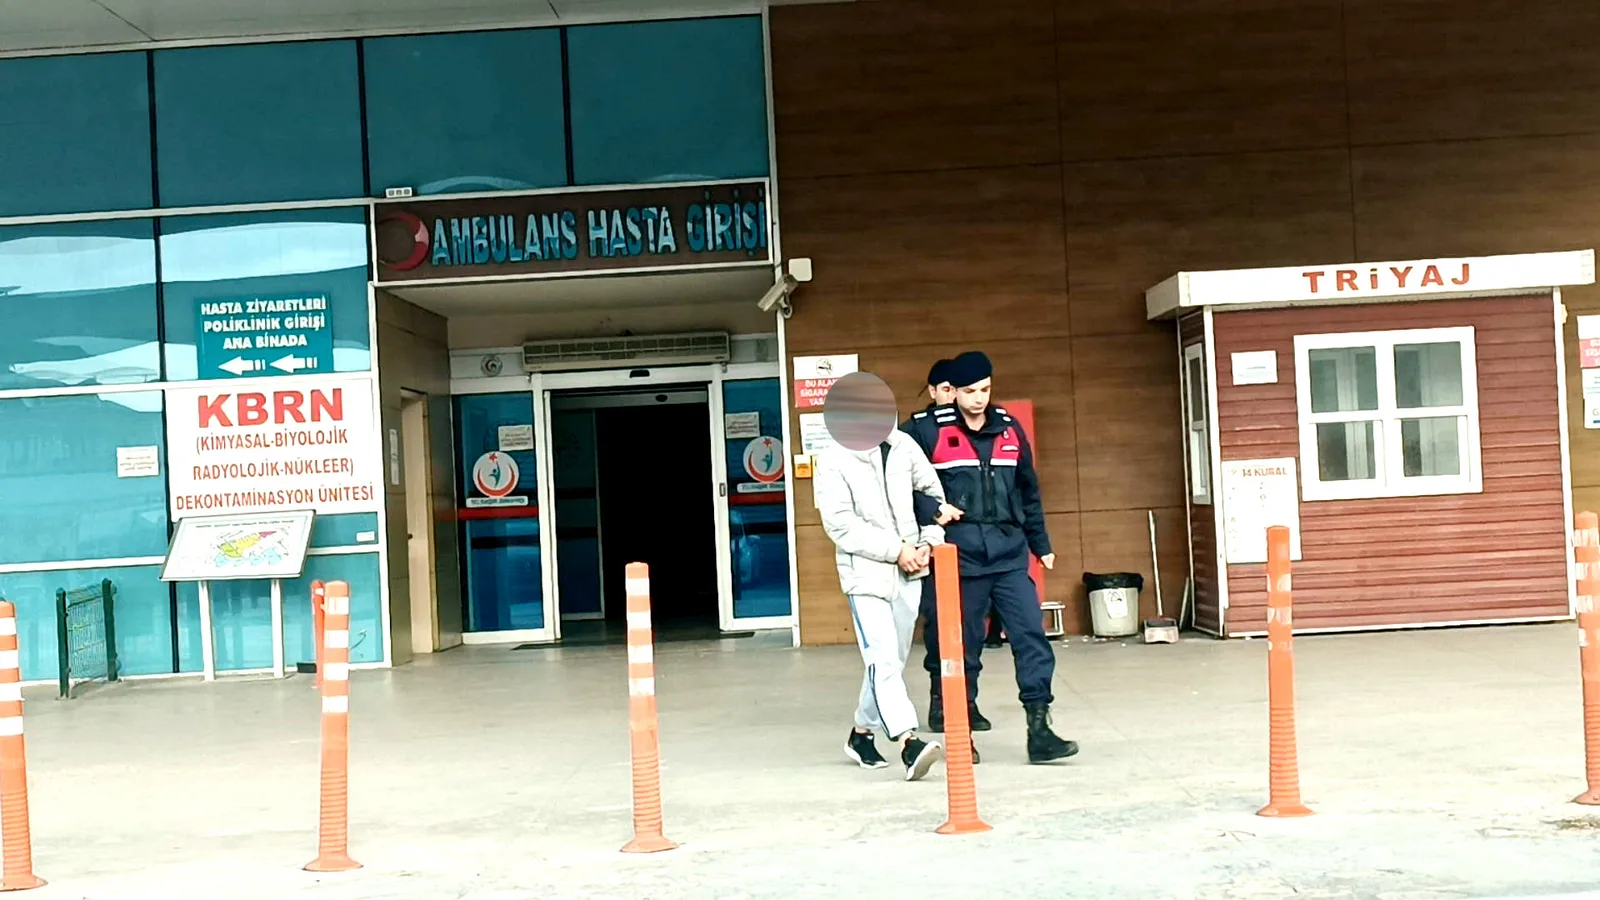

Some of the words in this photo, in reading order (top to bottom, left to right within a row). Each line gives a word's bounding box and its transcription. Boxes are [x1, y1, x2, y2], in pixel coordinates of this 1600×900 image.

[431, 210, 577, 266] AMBULANS
[587, 206, 676, 257] HASTA
[686, 188, 766, 256] GİRİŞİ
[201, 302, 242, 315] HASTA
[246, 295, 326, 313] ZİYARETLERİ
[204, 315, 281, 333] POLİKLİNİK
[284, 312, 325, 331] GİRİŞİ
[223, 336, 252, 350] ANA
[255, 332, 307, 348] BİNADA
[198, 388, 343, 428] KBRN
[196, 426, 348, 454] (KİMYASAL-BİYOLOJİK
[193, 457, 354, 481] RADYOLOJİK-NÜKLEER)
[176, 488, 314, 511] DEKONTAMİNASYON
[318, 482, 374, 503] ÜNİTESİ
